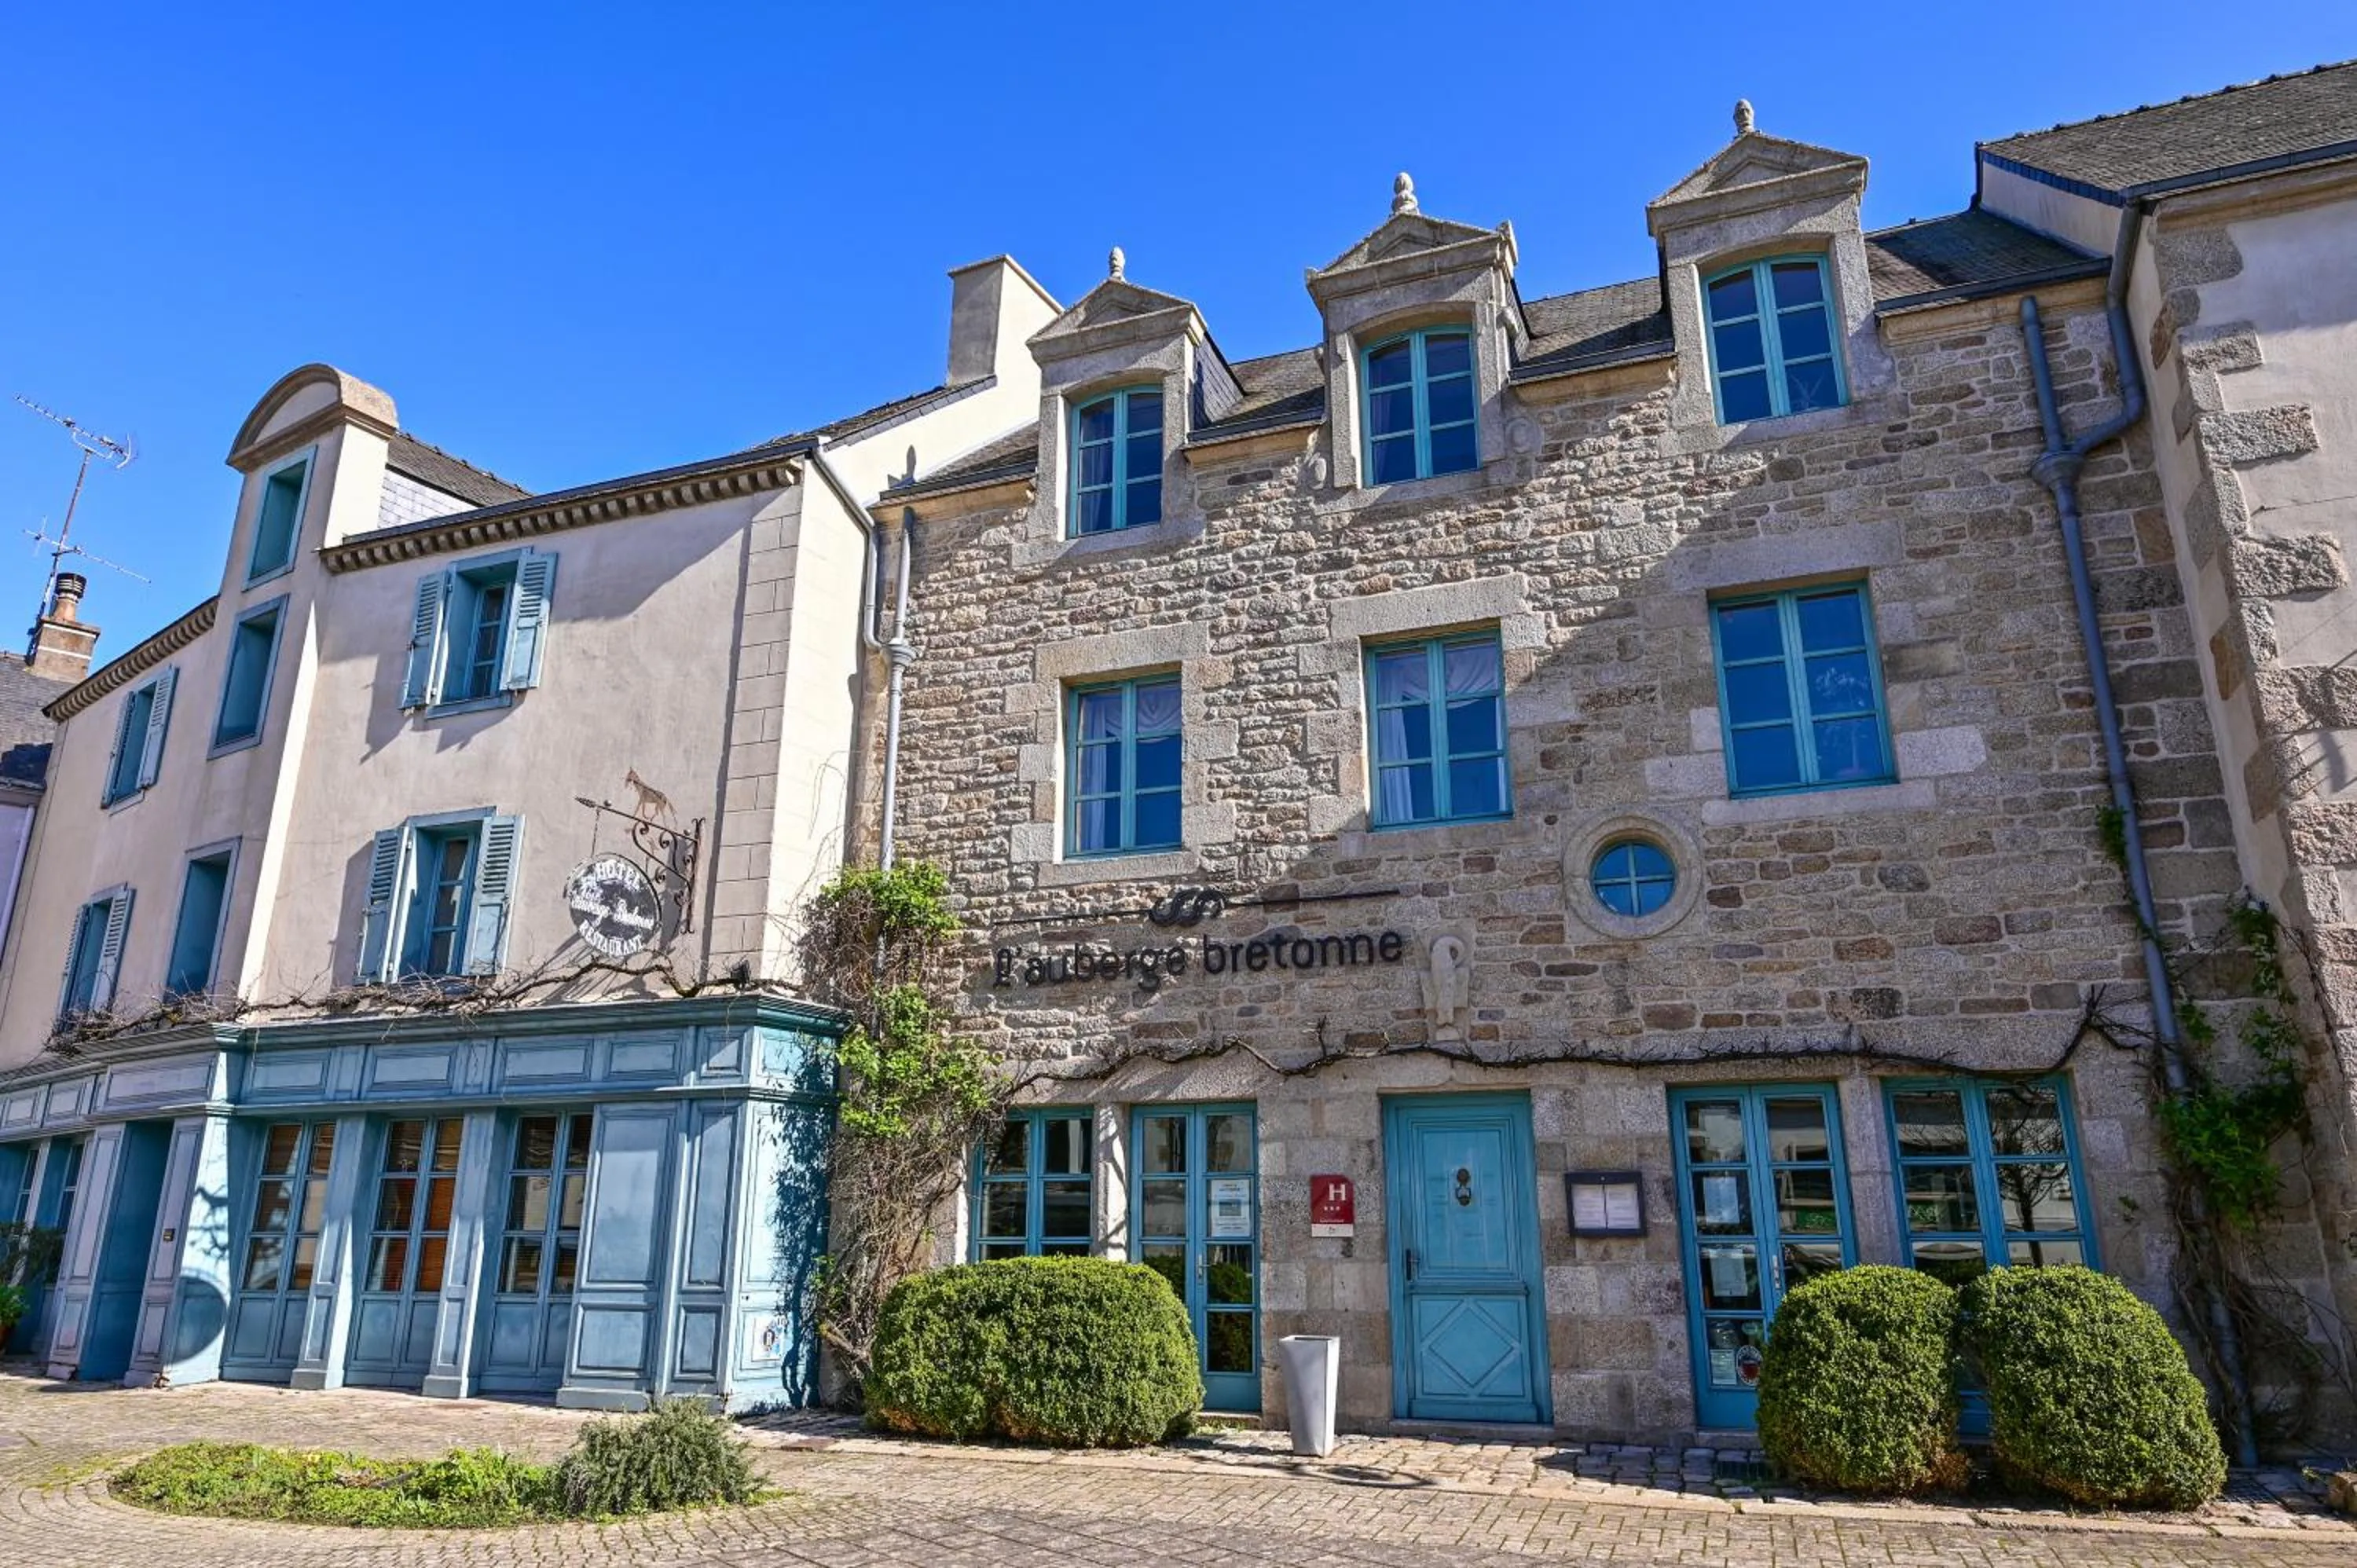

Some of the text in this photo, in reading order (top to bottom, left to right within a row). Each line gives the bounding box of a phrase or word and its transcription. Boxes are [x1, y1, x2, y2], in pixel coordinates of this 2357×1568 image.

[579, 919, 643, 956] RESTAURANT
[1203, 932, 1403, 975] bretonne
[1329, 1184, 1346, 1201] H
